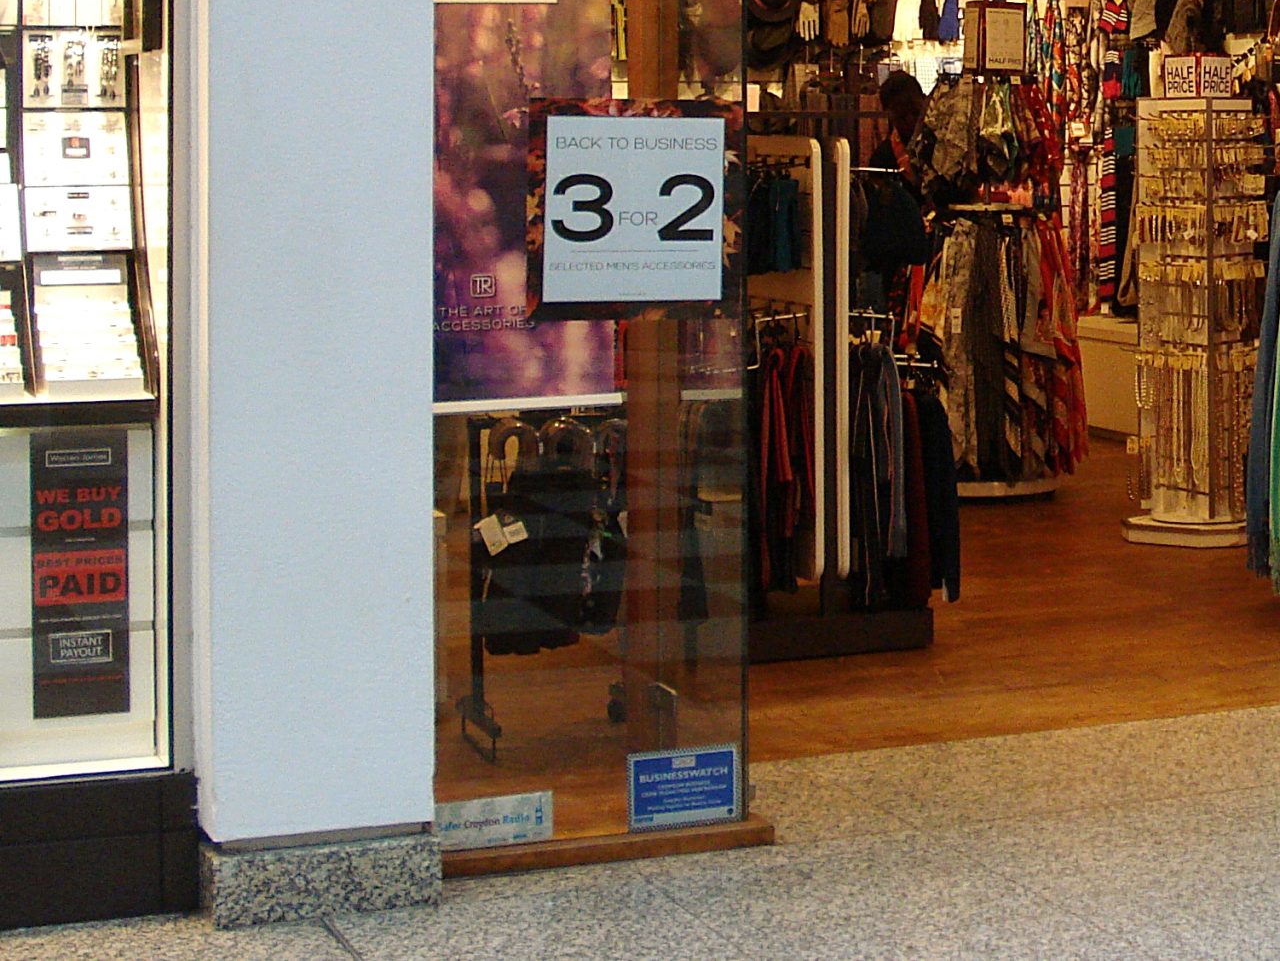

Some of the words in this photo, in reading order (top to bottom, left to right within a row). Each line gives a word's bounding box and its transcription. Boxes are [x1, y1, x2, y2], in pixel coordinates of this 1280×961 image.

[1167, 65, 1194, 80] HALF
[1203, 65, 1230, 80] HALF
[1167, 81, 1194, 94] PRICE
[1203, 81, 1230, 94] PRICE
[555, 136, 601, 150] BACK
[607, 137, 629, 150] TO
[634, 137, 718, 151] BUSINESS
[551, 173, 615, 243] 3
[618, 211, 659, 226] FOR
[657, 173, 715, 242] 2
[549, 261, 604, 271] SELECTED
[606, 261, 639, 271] MEN'S
[641, 261, 716, 271] ACCESSORIES
[440, 306, 468, 318] THE
[472, 305, 504, 317] ART
[508, 304, 528, 317] OF
[433, 317, 536, 333] ACCESSORIES
[35, 488, 70, 505] WE
[76, 485, 122, 503] BUY
[36, 507, 123, 532] GOLD
[36, 558, 69, 569] BEST
[75, 555, 122, 567] PRICES
[39, 571, 122, 599] PAID
[60, 637, 103, 647] INSTANT
[60, 646, 103, 658] PAYOUT
[639, 766, 728, 784] BUSINESSWATCH
[463, 816, 500, 830] Croydon
[502, 813, 530, 825] Radio
